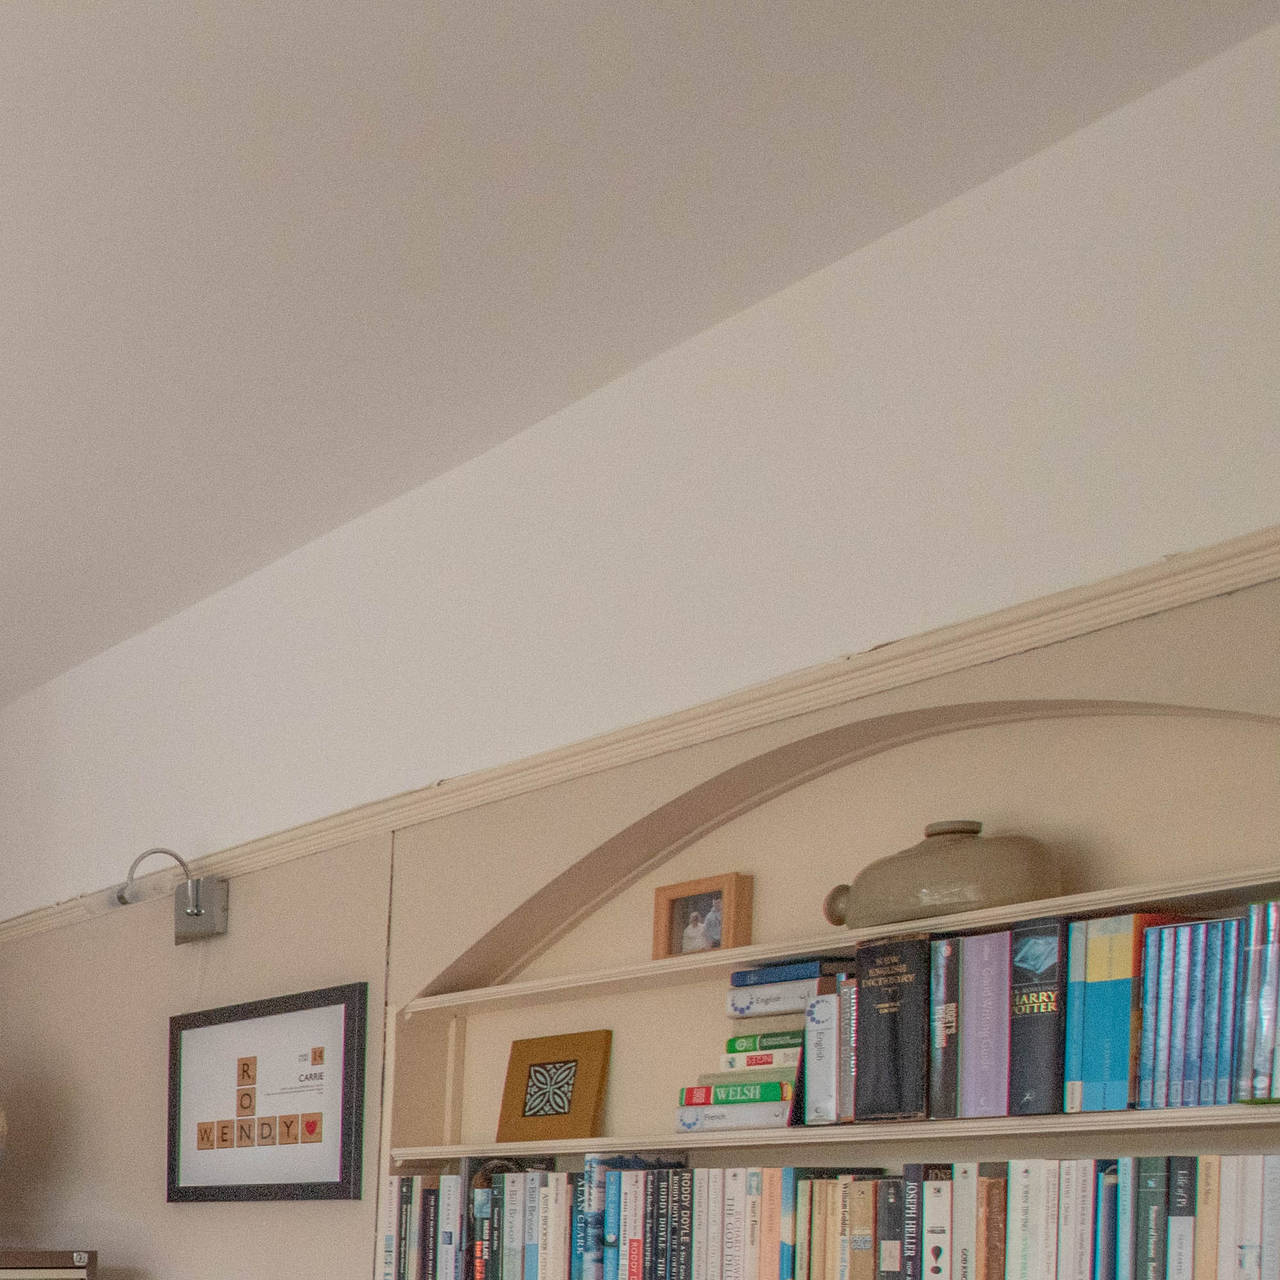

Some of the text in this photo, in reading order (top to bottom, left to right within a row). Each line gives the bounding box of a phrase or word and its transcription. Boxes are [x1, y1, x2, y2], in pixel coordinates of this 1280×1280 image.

[815, 1032, 824, 1061] English
[298, 1072, 325, 1082] CARRIE
[716, 1086, 760, 1100] WELSH
[659, 1182, 667, 1214] RODDY
[682, 1173, 690, 1207] RODDY
[905, 1181, 918, 1217] JOSEPH
[1175, 1170, 1189, 1207] Life of Pi
[726, 1197, 734, 1217] THE
[527, 1206, 535, 1242] Bryson
[658, 1218, 666, 1249] DOYLE
[680, 1210, 689, 1242] DOYLE
[725, 1223, 734, 1249] GOD
[904, 1221, 917, 1256] HELLER
[657, 1259, 665, 1277] THE
